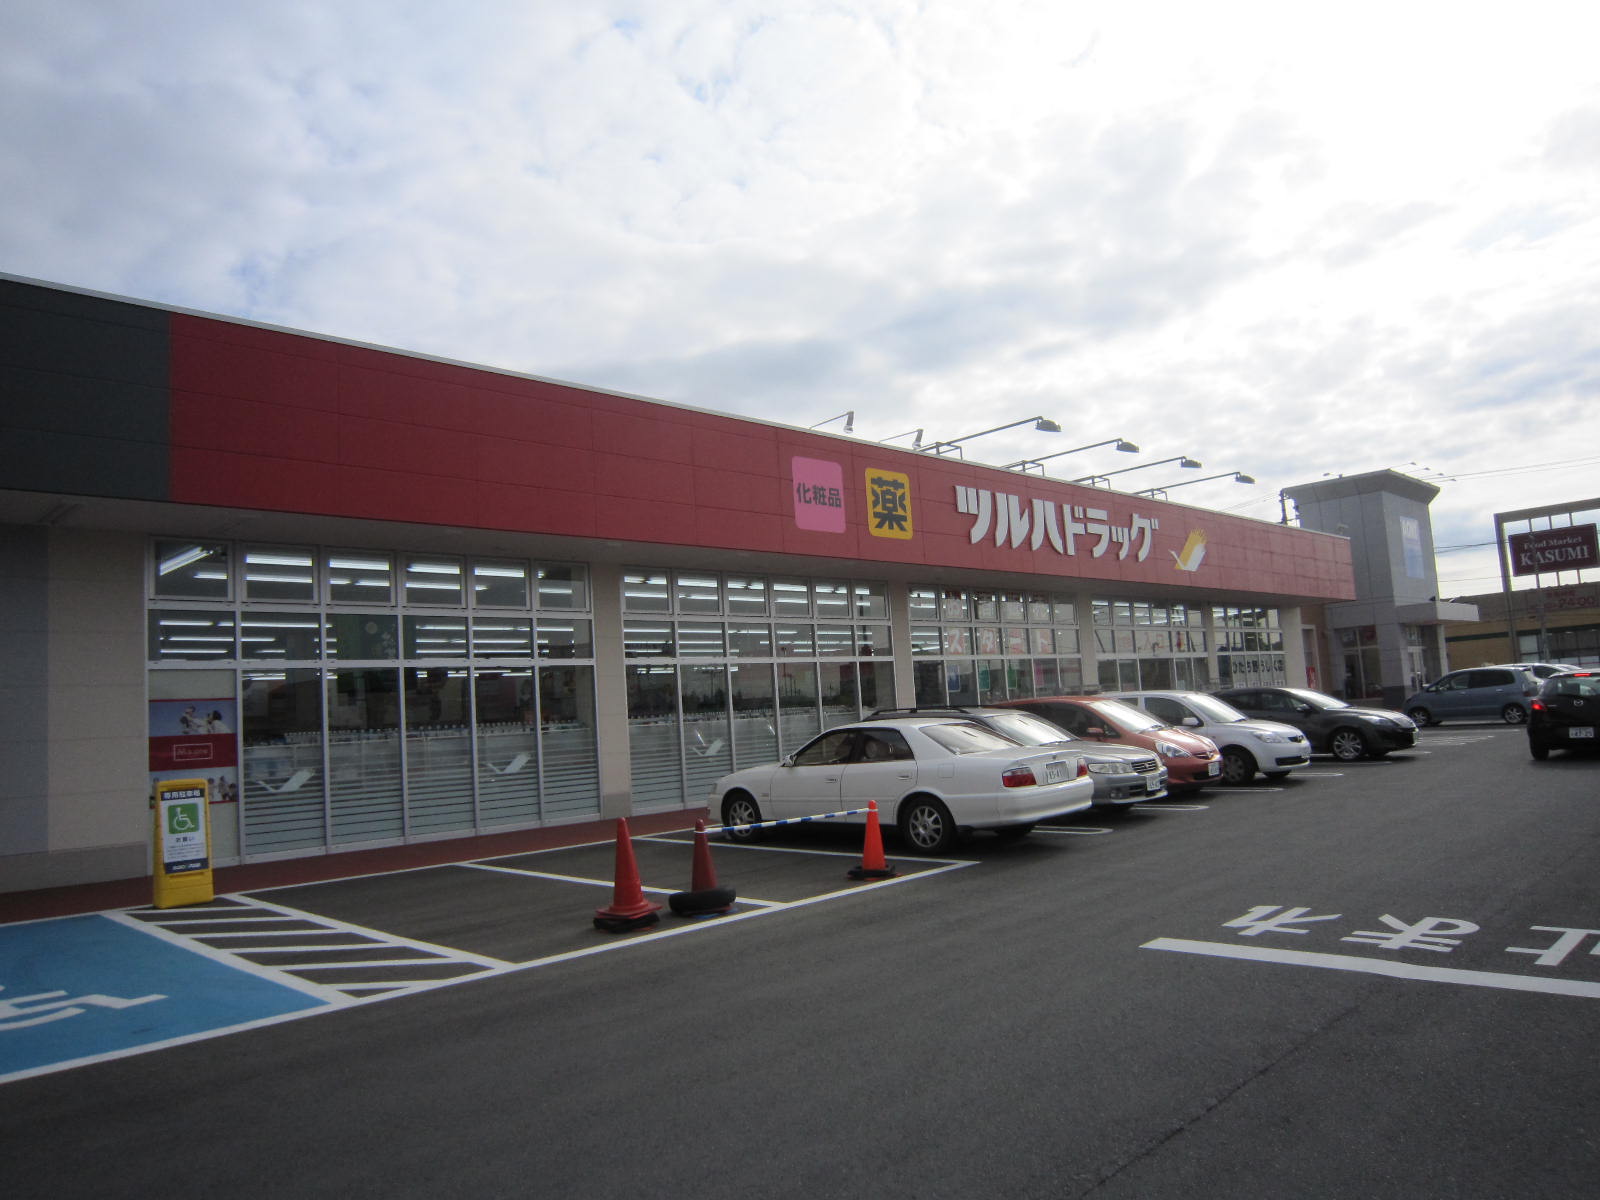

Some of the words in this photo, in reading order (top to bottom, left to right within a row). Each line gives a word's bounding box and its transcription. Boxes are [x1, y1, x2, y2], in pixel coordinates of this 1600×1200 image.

[797, 482, 842, 508] 化粧品
[870, 476, 908, 532] 薬
[955, 486, 1160, 562] ツルハドラッグ
[1548, 536, 1583, 546] Market
[1520, 545, 1590, 567] KASUMI
